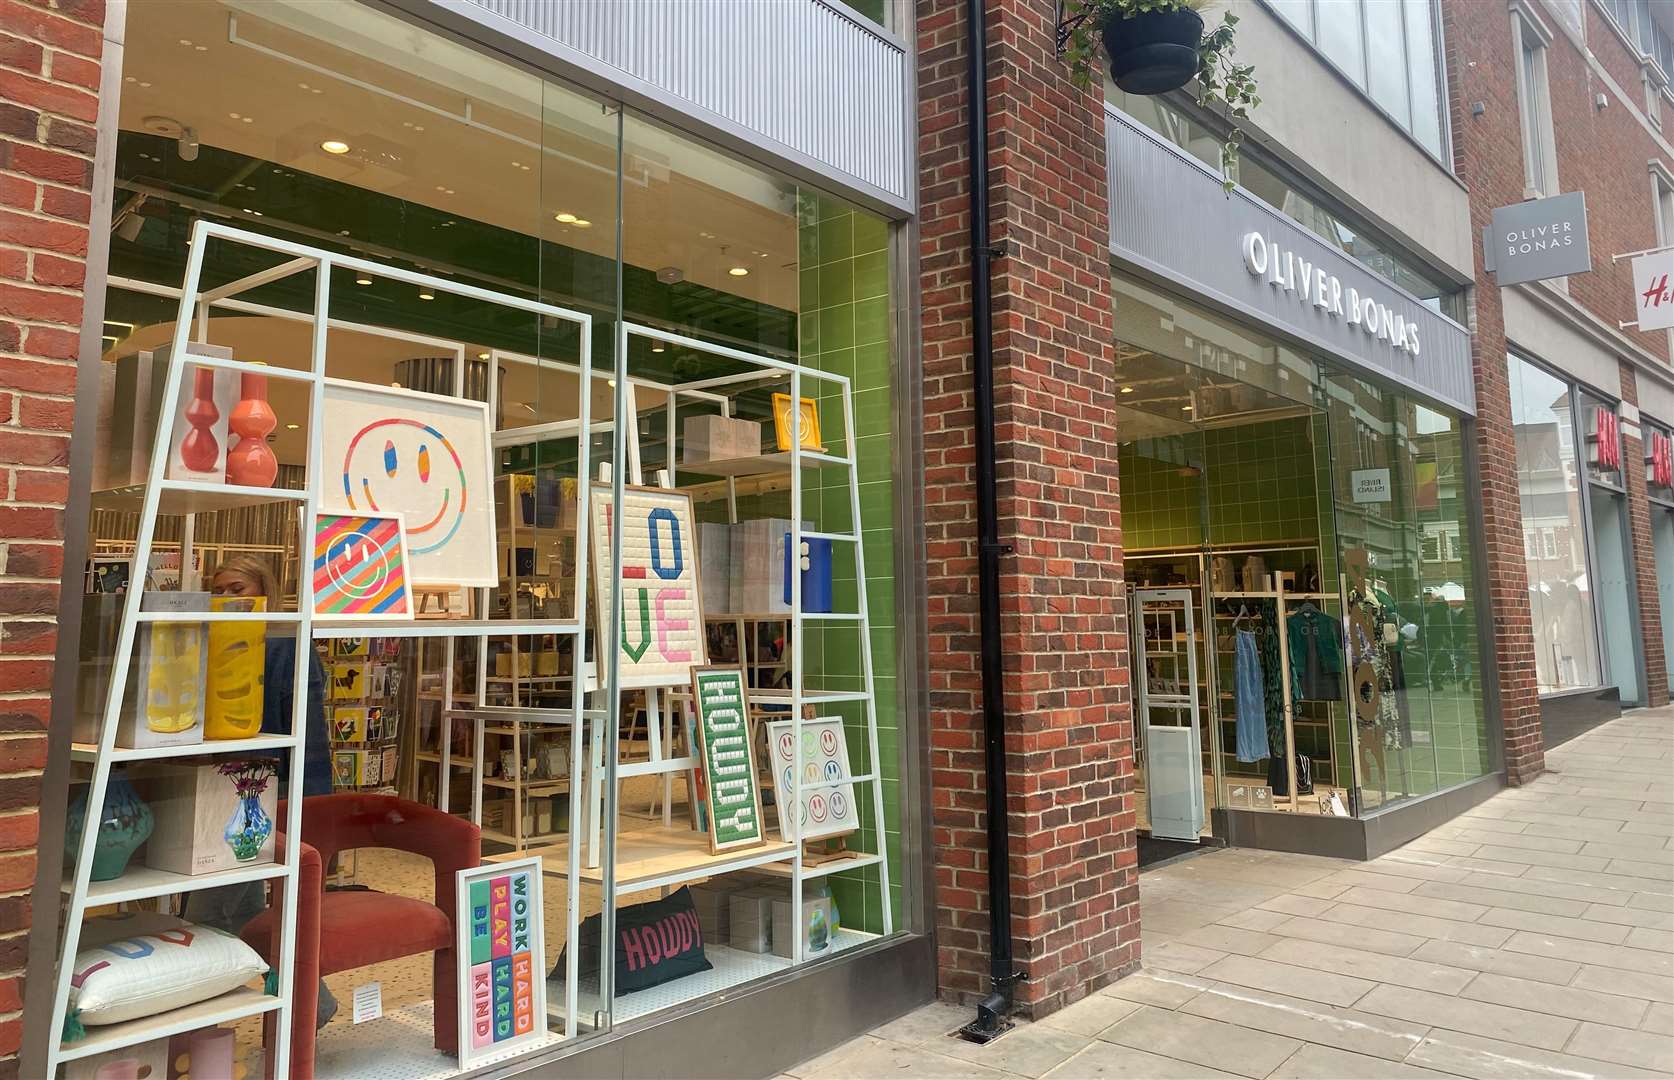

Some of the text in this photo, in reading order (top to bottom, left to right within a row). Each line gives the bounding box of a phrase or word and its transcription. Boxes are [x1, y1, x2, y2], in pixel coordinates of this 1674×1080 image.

[1243, 231, 1420, 356] OLIVER BONAS
[1506, 221, 1572, 242] OLIVER
[1508, 235, 1573, 256] BONAS
[1642, 273, 1674, 308] H&
[703, 680, 754, 832] HOWDY
[474, 905, 489, 1037] BE KIND
[494, 885, 510, 1036] PLAY HARD
[514, 875, 529, 1029] WORK HARD
[622, 908, 701, 972] HOWDY
